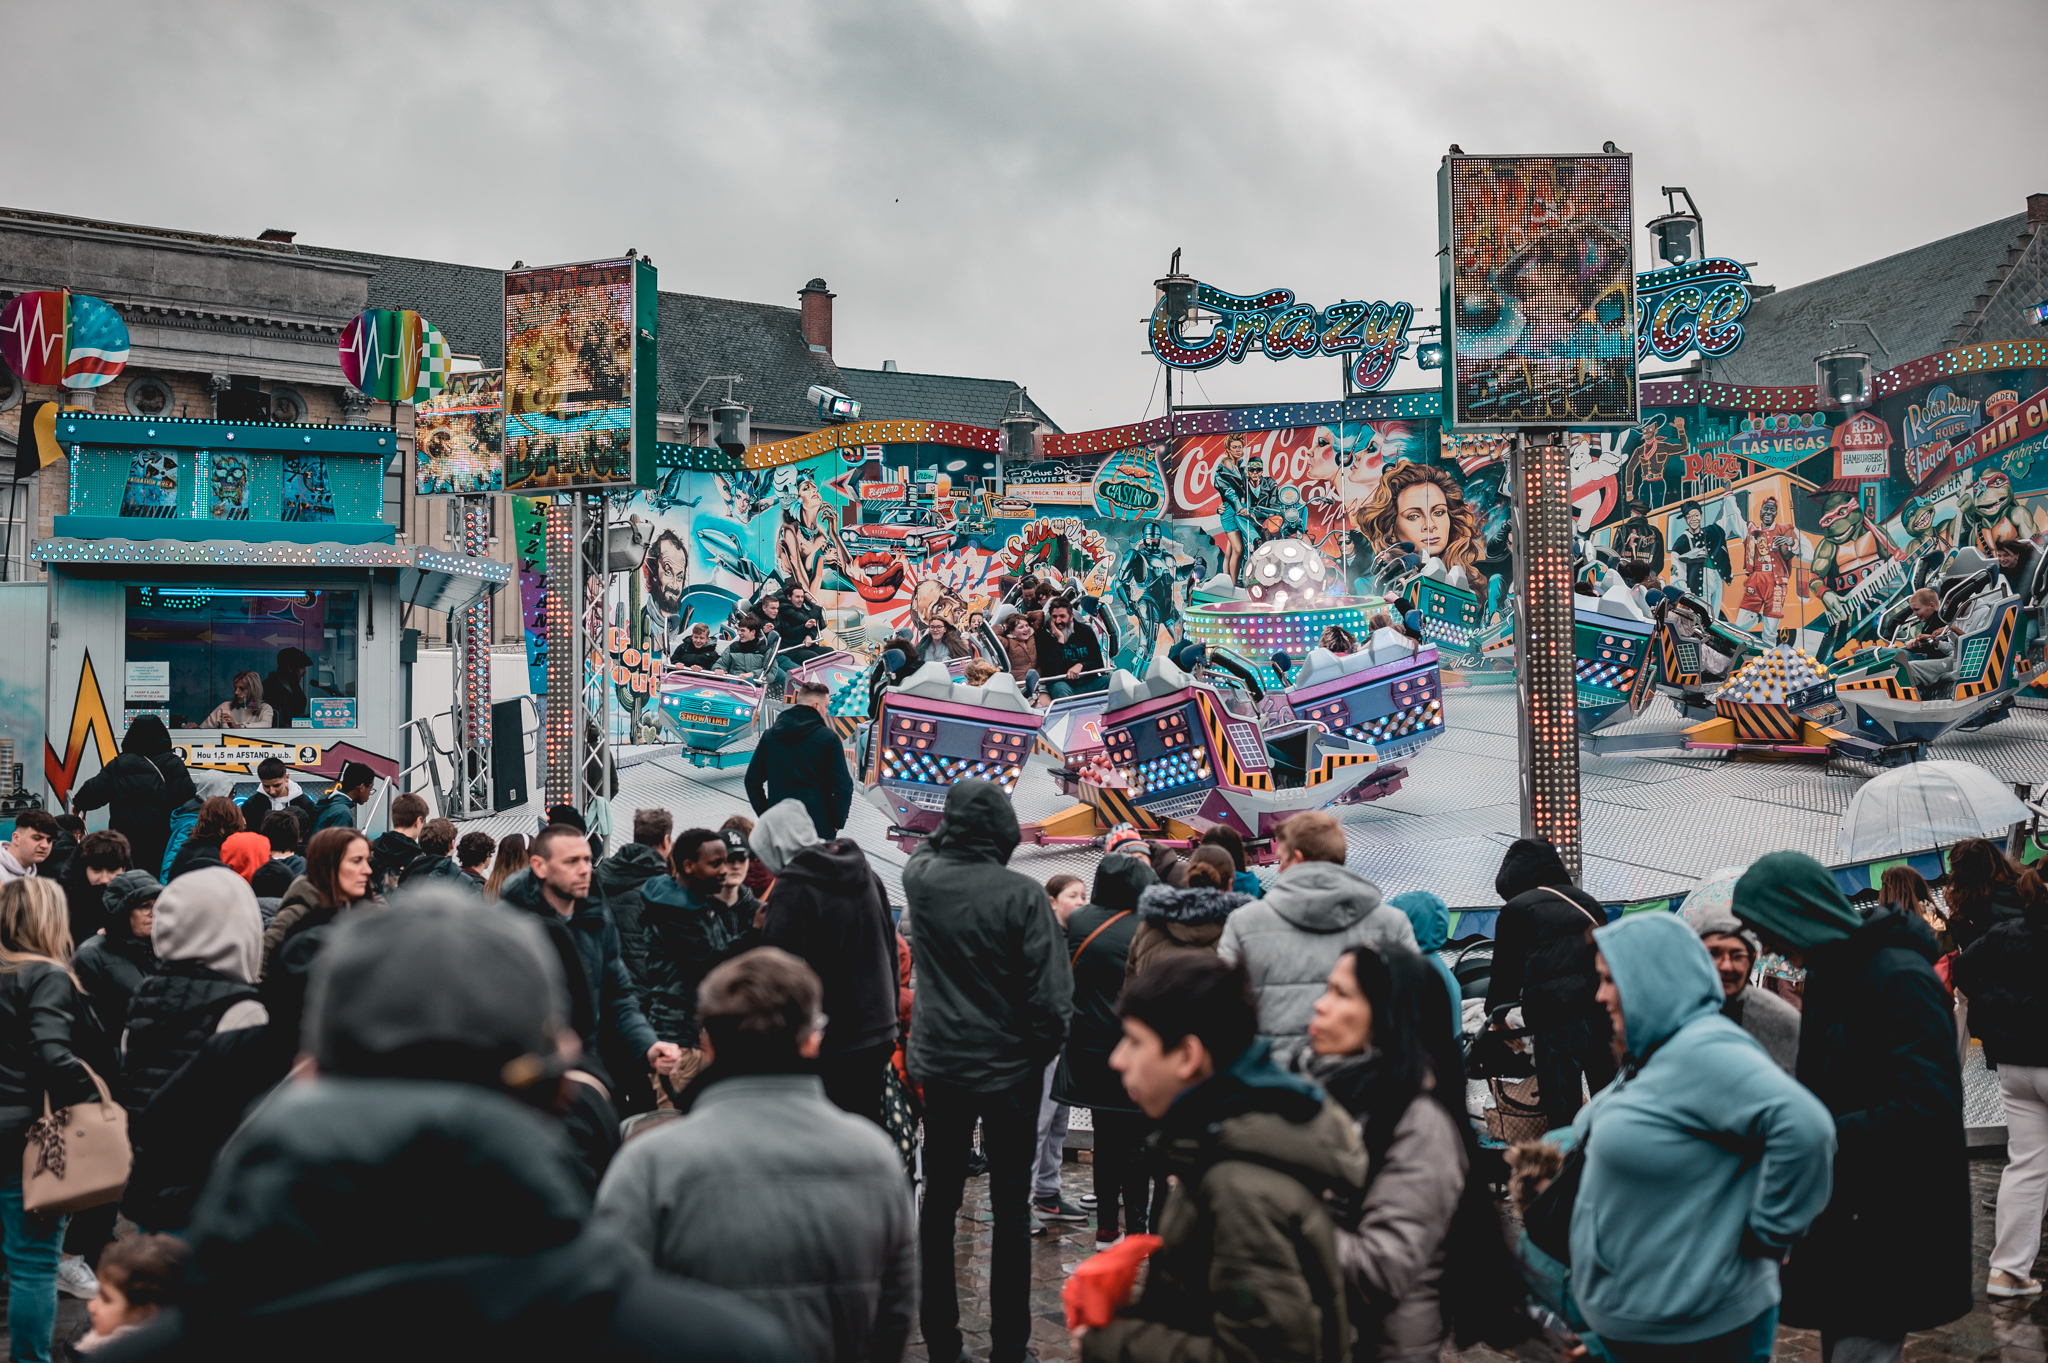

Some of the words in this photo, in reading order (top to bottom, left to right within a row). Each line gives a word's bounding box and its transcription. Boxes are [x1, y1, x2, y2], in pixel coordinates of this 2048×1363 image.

[1149, 281, 1414, 392] Crazy
[1986, 392, 2017, 407] GOLDEN
[1740, 411, 1826, 432] WELCOME
[1851, 417, 1876, 433] RED
[1908, 399, 1947, 442] ROGER
[1845, 433, 1884, 446] BARN
[1935, 421, 1967, 441] HOUSE
[1955, 441, 1979, 467] BAR
[1981, 414, 2020, 455] HIT
[1697, 440, 1725, 450] UNION
[1742, 440, 1770, 456] LAS
[1774, 435, 1826, 453] VEGAS
[1681, 451, 1741, 483] Plaza
[1843, 451, 1883, 465] HAMBURGERS
[1910, 443, 1949, 475] Sugar
[1865, 464, 1884, 473] HOT
[1026, 476, 1065, 484] MOVIES
[1105, 484, 1152, 506] CASINO
[1864, 485, 1876, 520] NIG
[680, 711, 706, 723] SHOW
[707, 715, 729, 726] TIME
[197, 751, 212, 759] Hou
[214, 751, 225, 761] 1,5
[236, 751, 270, 759] AFSTAND
[271, 751, 292, 759] a.u.b.
